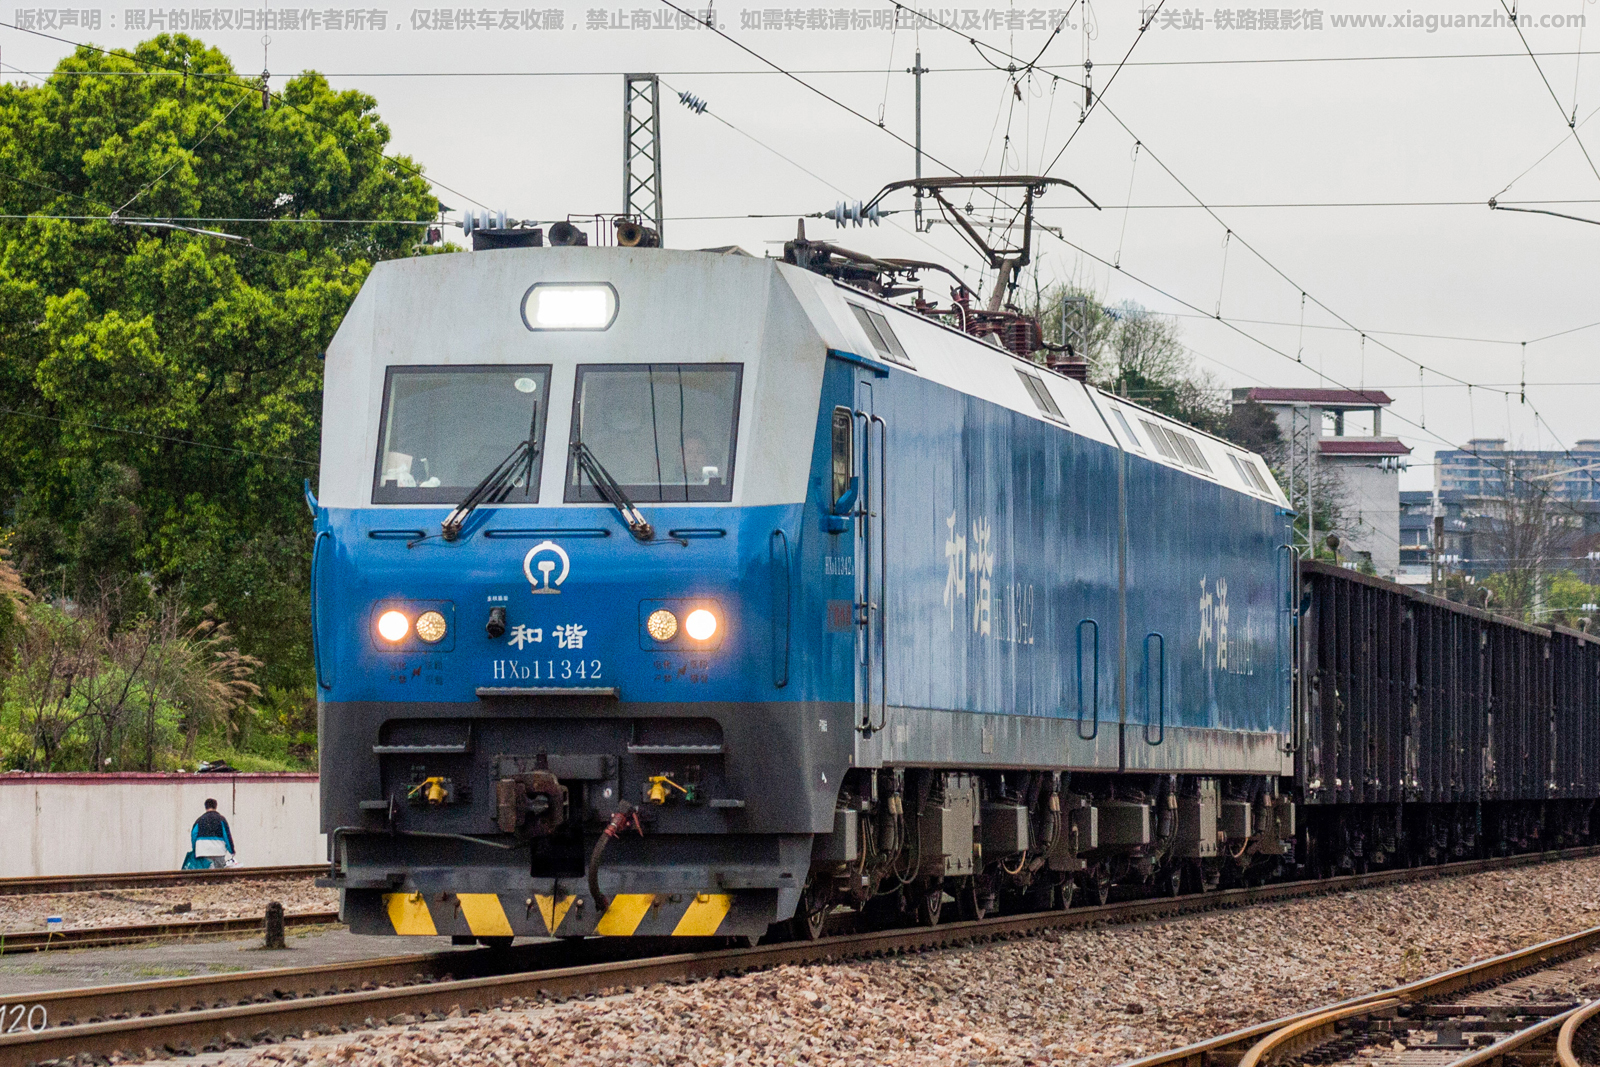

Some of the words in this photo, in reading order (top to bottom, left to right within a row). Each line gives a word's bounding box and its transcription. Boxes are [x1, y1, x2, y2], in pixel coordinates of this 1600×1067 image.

[508, 623, 589, 651] 和谐
[493, 659, 603, 680] HXD11342
[0, 1004, 47, 1034] 120
